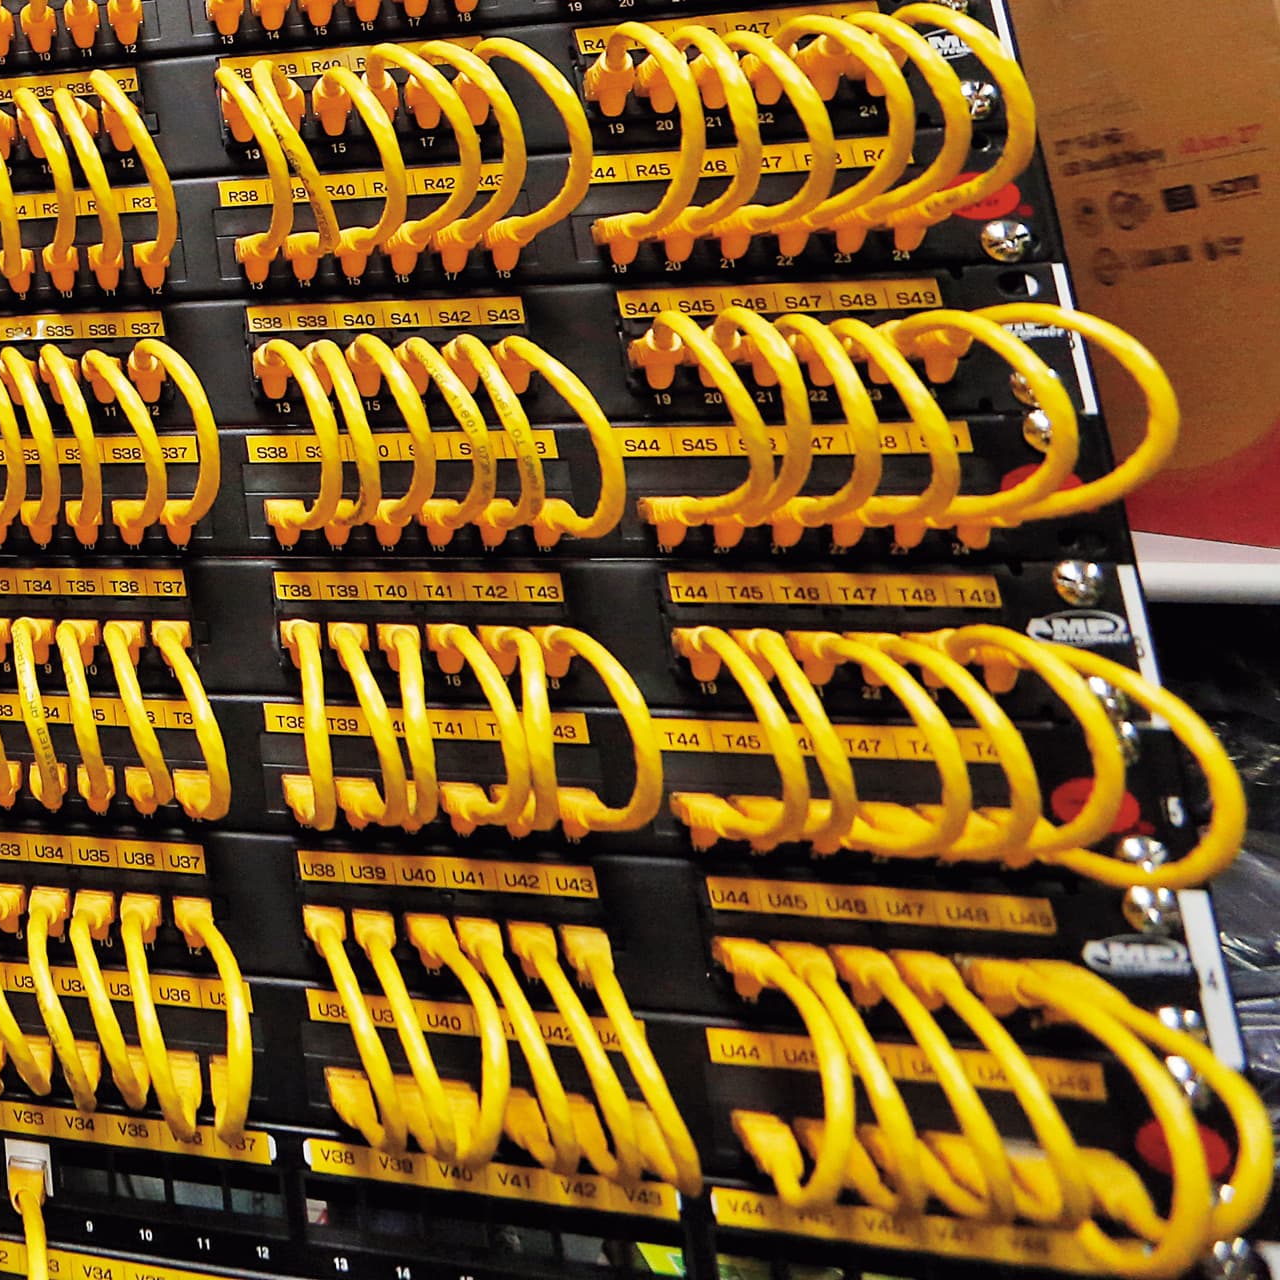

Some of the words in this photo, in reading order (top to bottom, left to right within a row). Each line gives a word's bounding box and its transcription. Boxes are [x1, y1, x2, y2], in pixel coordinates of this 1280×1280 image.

[568, 2, 583, 12] 19
[220, 36, 233, 45] 13
[314, 26, 327, 36] 15
[361, 22, 374, 31] 16
[457, 13, 472, 23] 18
[124, 44, 137, 54] 12
[608, 123, 625, 133] 19
[420, 137, 435, 147] 17
[120, 159, 134, 168] 12
[636, 163, 671, 176] R45
[228, 190, 258, 203] R38
[424, 177, 454, 190] R42
[625, 303, 661, 314] S44
[678, 300, 714, 312] S45
[785, 296, 821, 309] S47
[840, 294, 876, 306] S48
[896, 291, 935, 304] S49
[252, 316, 282, 329] S38
[297, 315, 327, 327] S39
[390, 312, 420, 325] S41
[487, 308, 520, 321] S43
[89, 324, 117, 336] S36
[131, 323, 159, 334] S37
[257, 446, 288, 459] S38
[624, 440, 660, 451] S44
[112, 448, 140, 459] S36
[23, 580, 52, 591] T34
[67, 580, 95, 592] T35
[153, 581, 182, 593] T37
[280, 584, 312, 597] T38
[327, 585, 359, 598] T39
[375, 585, 408, 598] T40
[472, 585, 509, 599] T42
[525, 586, 559, 599] T43
[671, 586, 708, 599] T44
[726, 586, 763, 600] T45
[837, 588, 876, 601] T47
[326, 718, 359, 730] T39
[433, 722, 463, 735] T41
[664, 733, 700, 746] T44
[845, 740, 881, 753] T47
[35, 845, 64, 859] U34
[79, 849, 110, 862] U35
[169, 855, 200, 869] U37
[303, 862, 335, 878] U38
[350, 865, 386, 881] U39
[402, 868, 436, 884] U40
[504, 873, 540, 890] U42
[556, 876, 593, 893] U43
[712, 888, 749, 905] U44
[160, 987, 191, 1002] U36
[427, 1013, 461, 1031] U40
[721, 1043, 761, 1060] U44
[64, 1116, 95, 1132] V34
[117, 1122, 149, 1139] V35
[320, 1148, 355, 1166] V38
[379, 1156, 414, 1174] V39
[498, 1171, 531, 1190] V41
[85, 1221, 93, 1232] 9
[139, 1228, 153, 1241] 10
[197, 1237, 211, 1250] 11
[256, 1245, 270, 1260] 12
[333, 1257, 349, 1271] 13
